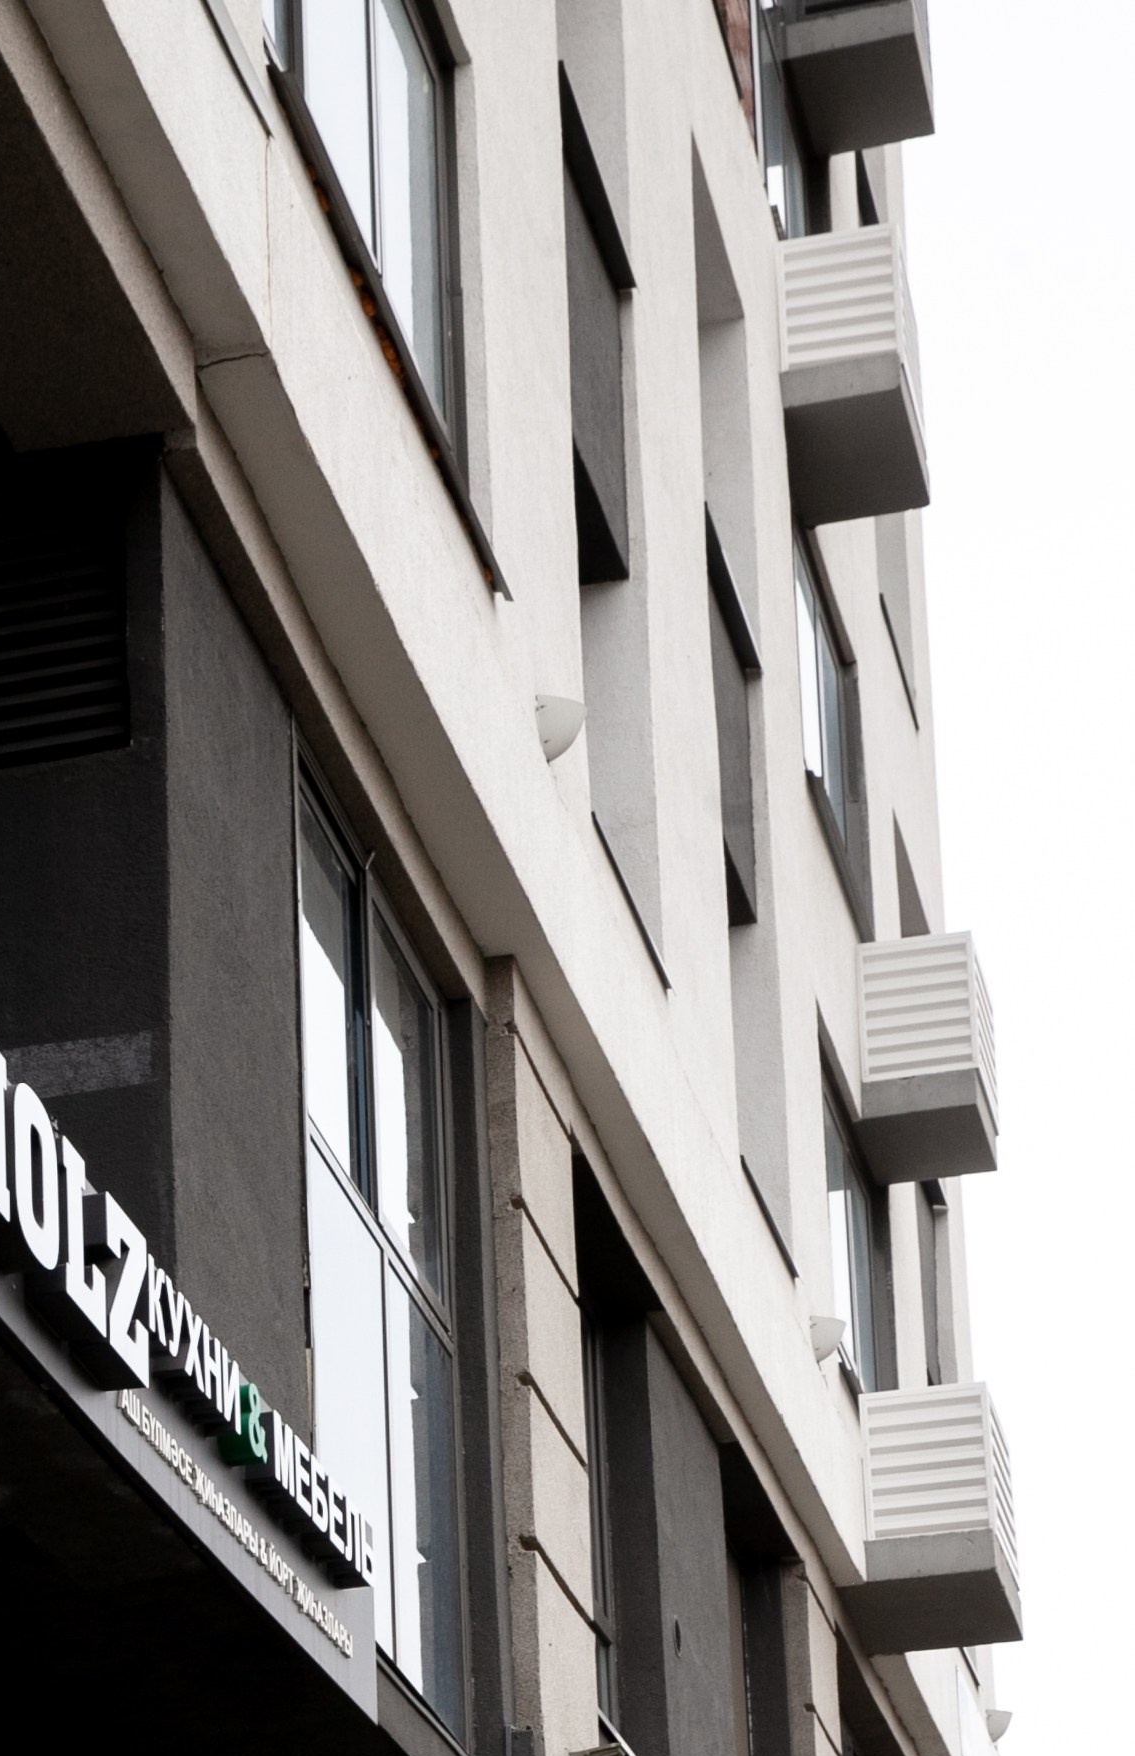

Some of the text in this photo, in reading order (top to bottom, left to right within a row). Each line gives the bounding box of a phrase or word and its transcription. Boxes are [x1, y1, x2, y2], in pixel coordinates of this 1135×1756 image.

[147, 1254, 376, 1588] КУХНИ & МЕБЕЛЬ
[269, 1543, 295, 1595] ЙОРТ
